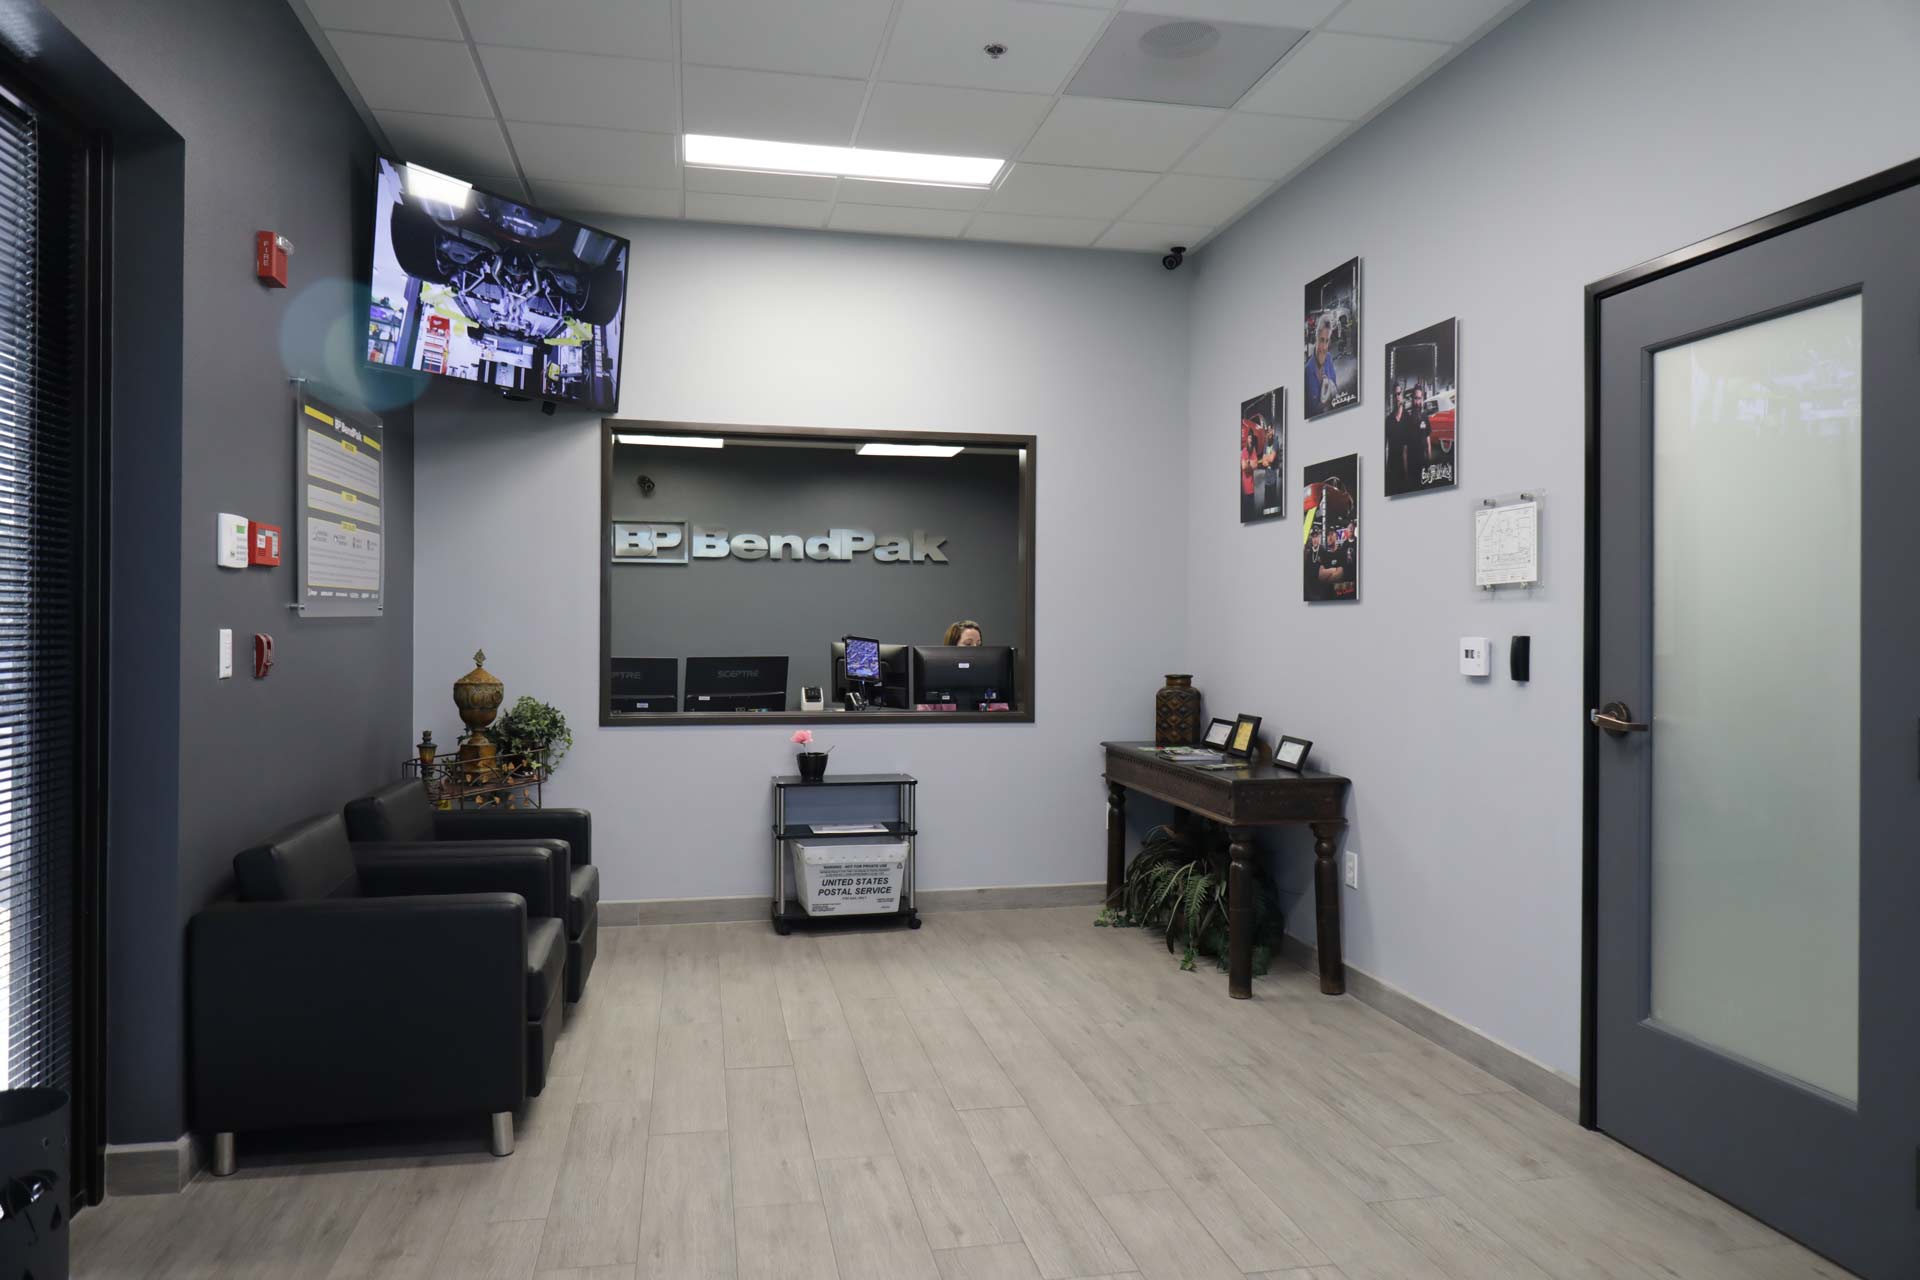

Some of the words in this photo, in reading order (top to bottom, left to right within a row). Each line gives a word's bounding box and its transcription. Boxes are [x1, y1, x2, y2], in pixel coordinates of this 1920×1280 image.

[613, 522, 685, 560] BP
[692, 524, 949, 563] BendPak
[822, 878, 854, 887] UNITED
[855, 877, 889, 885] STATES
[818, 888, 853, 896] POSTAL
[855, 886, 892, 895] SERVICE
